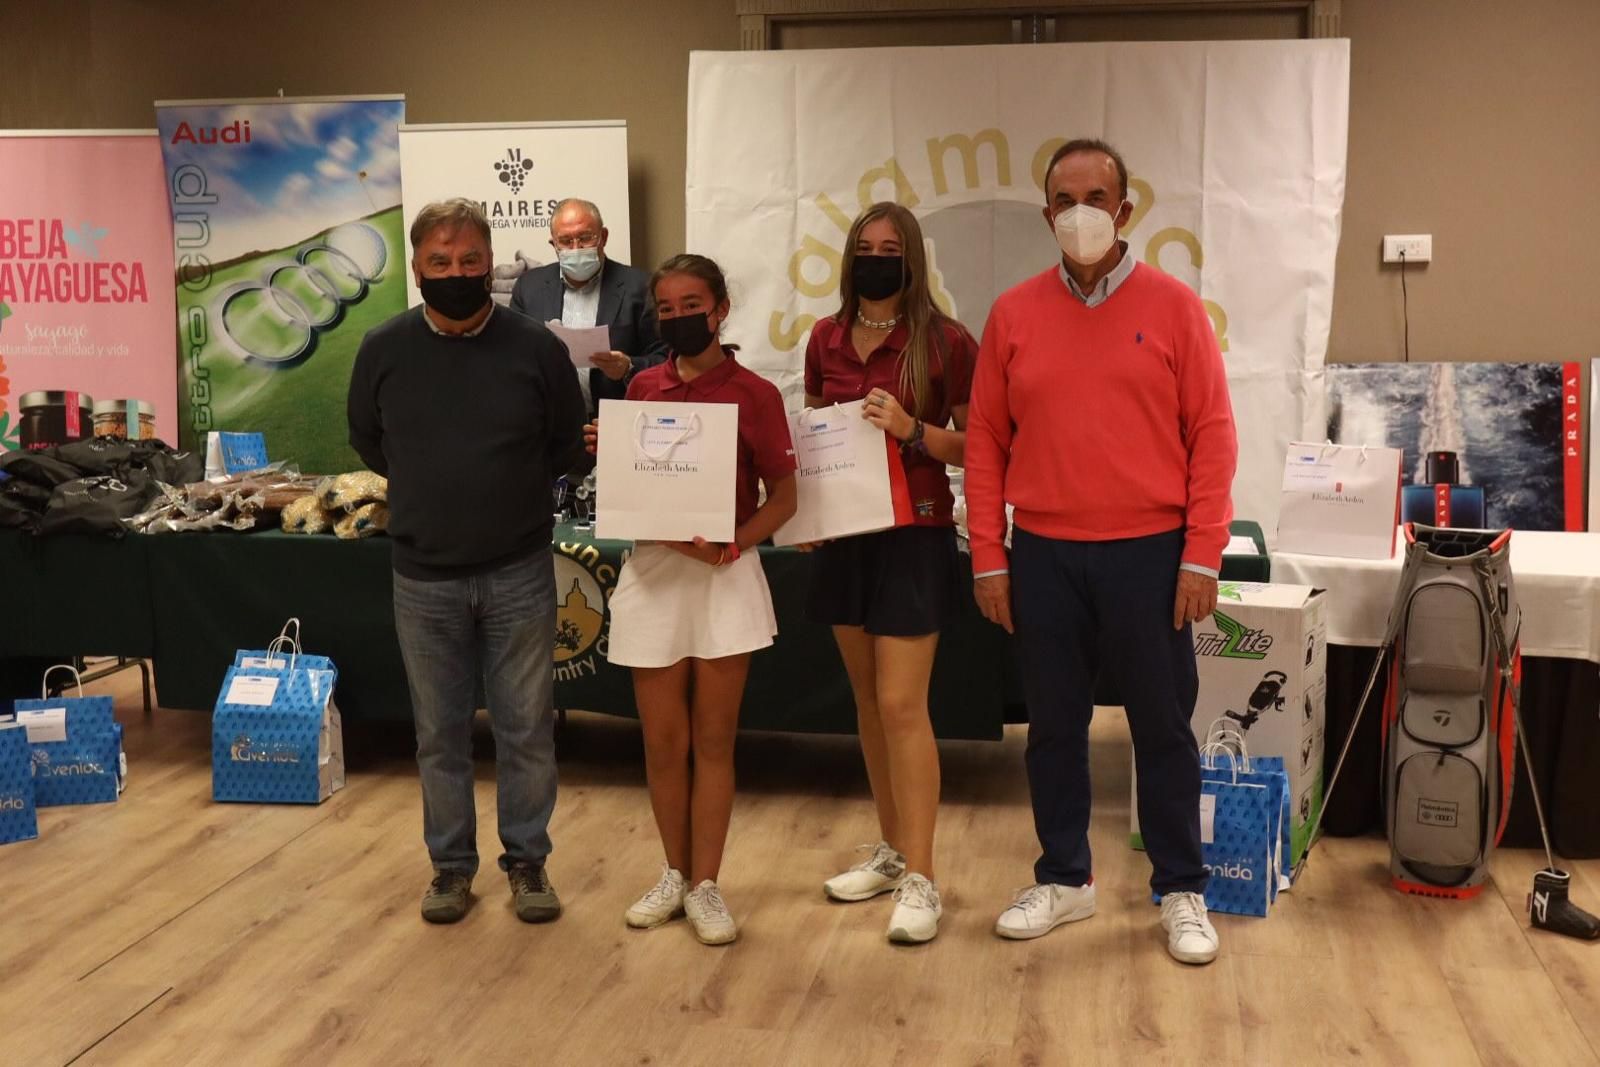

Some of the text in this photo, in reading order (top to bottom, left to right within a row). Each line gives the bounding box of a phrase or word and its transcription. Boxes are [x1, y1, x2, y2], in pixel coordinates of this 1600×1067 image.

[171, 121, 251, 145] Audi
[173, 163, 219, 293] cup
[512, 219, 519, 228] Y
[0, 219, 68, 259] BEJA
[0, 262, 149, 303] AYAGUESA
[106, 344, 129, 355] vida
[1566, 376, 1578, 457] PRADA
[634, 462, 698, 473] Elizabeth Arden
[800, 464, 833, 478] Elizabeth
[834, 460, 856, 472] Arden
